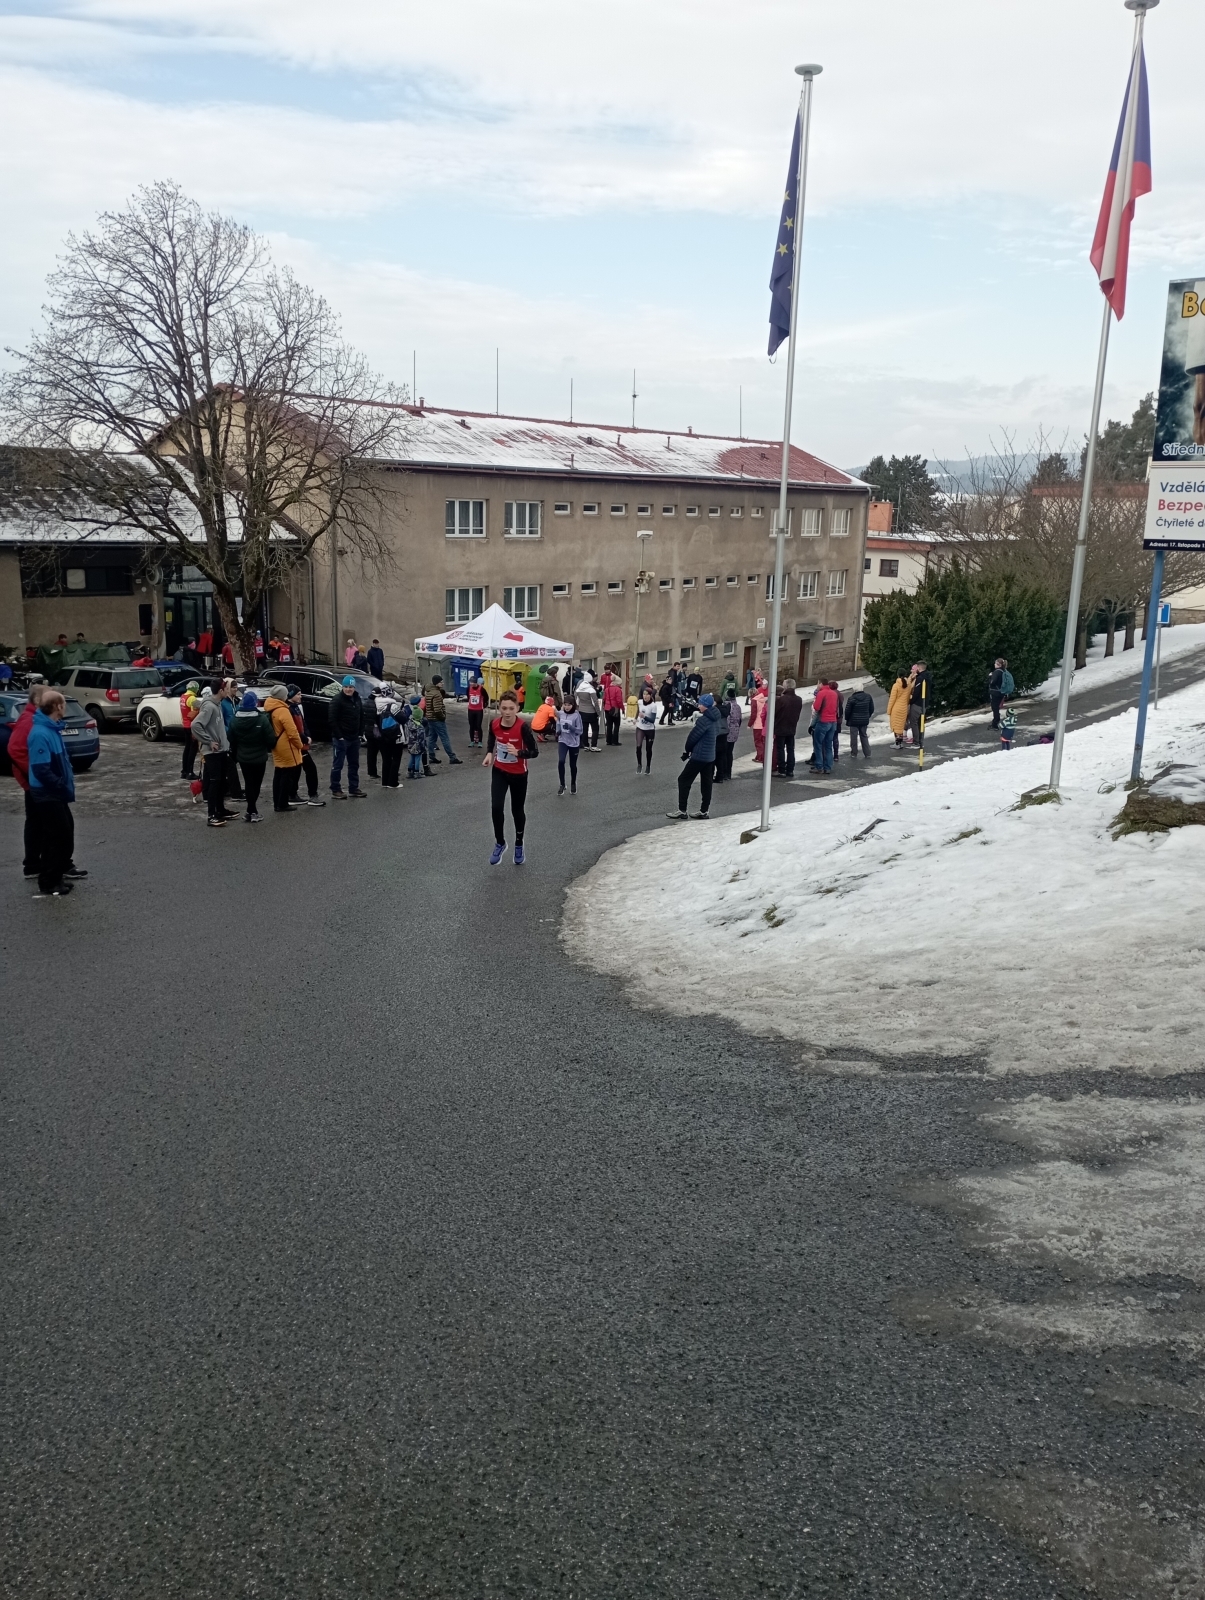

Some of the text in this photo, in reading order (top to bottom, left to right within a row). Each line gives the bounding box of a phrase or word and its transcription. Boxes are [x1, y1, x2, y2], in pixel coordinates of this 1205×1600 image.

[1181, 291, 1205, 318] B
[1162, 443, 1205, 456] Středn
[1158, 499, 1205, 513] Bezpe
[1156, 517, 1205, 528] Čtyřleté d
[502, 751, 509, 759] 7
